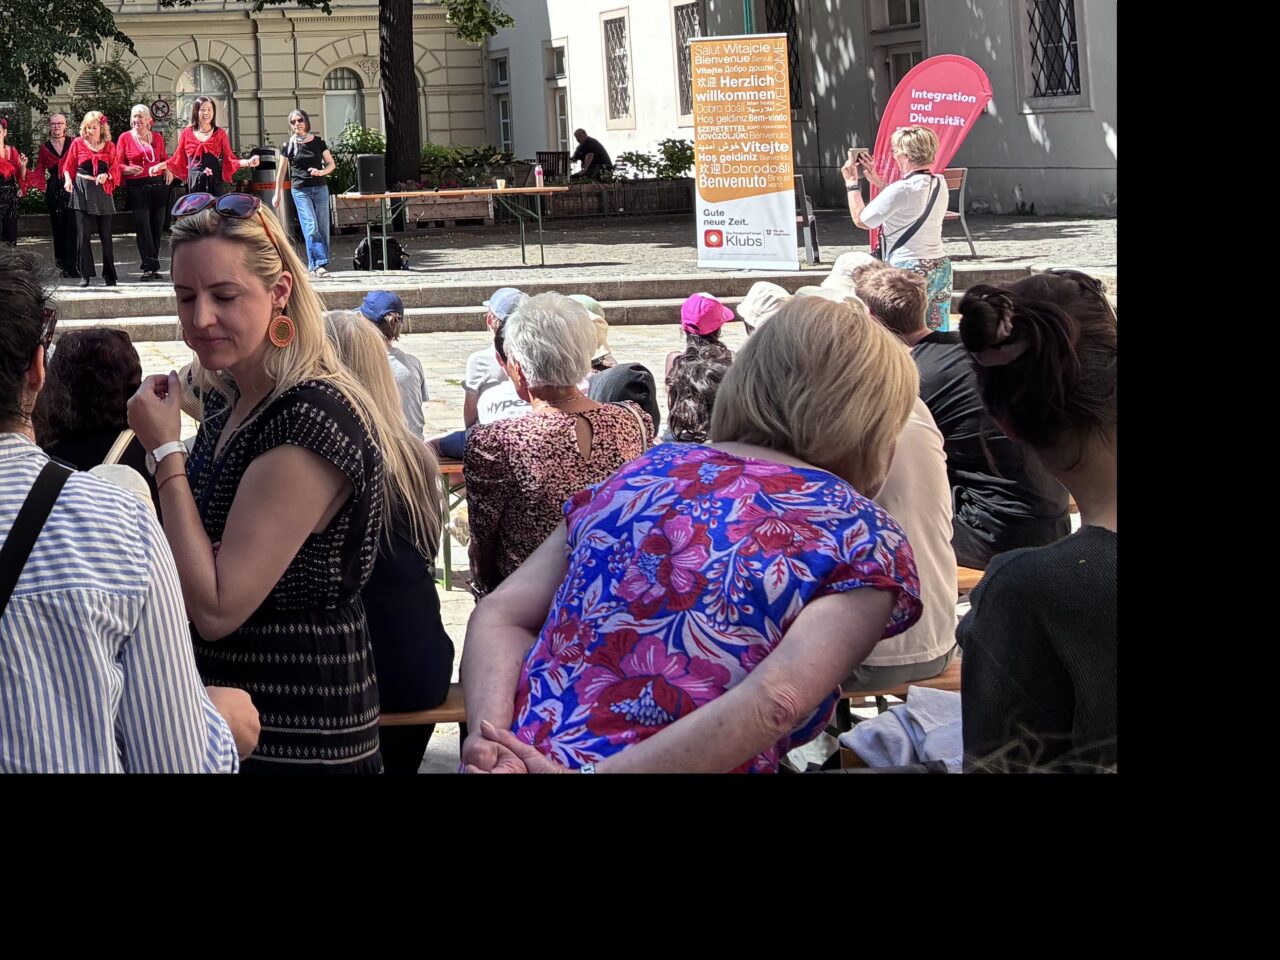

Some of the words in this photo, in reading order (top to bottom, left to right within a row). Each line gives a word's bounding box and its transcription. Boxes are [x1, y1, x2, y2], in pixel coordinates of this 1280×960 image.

[695, 44, 721, 56] Salut
[723, 43, 770, 55] Witajcie
[695, 55, 750, 65] Bienvenue
[720, 74, 774, 88] Herzlich
[773, 41, 787, 112] WELCOME
[696, 89, 775, 102] willkommen
[911, 89, 977, 104] Integration
[697, 103, 722, 113] Dobro
[910, 101, 932, 112] und
[717, 114, 748, 125] geldiniz
[748, 113, 788, 122] Bem-vindo
[909, 113, 966, 127] Diversität
[697, 125, 747, 133] SZERETETTEL
[741, 141, 790, 155] Vítejte
[698, 152, 717, 163] Hoş
[719, 151, 758, 164] geldiniz
[722, 162, 790, 174] Dobrodošli
[699, 173, 767, 188] Benvenuto
[703, 208, 725, 217] Gute
[703, 218, 726, 226] neue
[728, 217, 749, 226] Zeit.
[726, 235, 763, 247] Klubs
